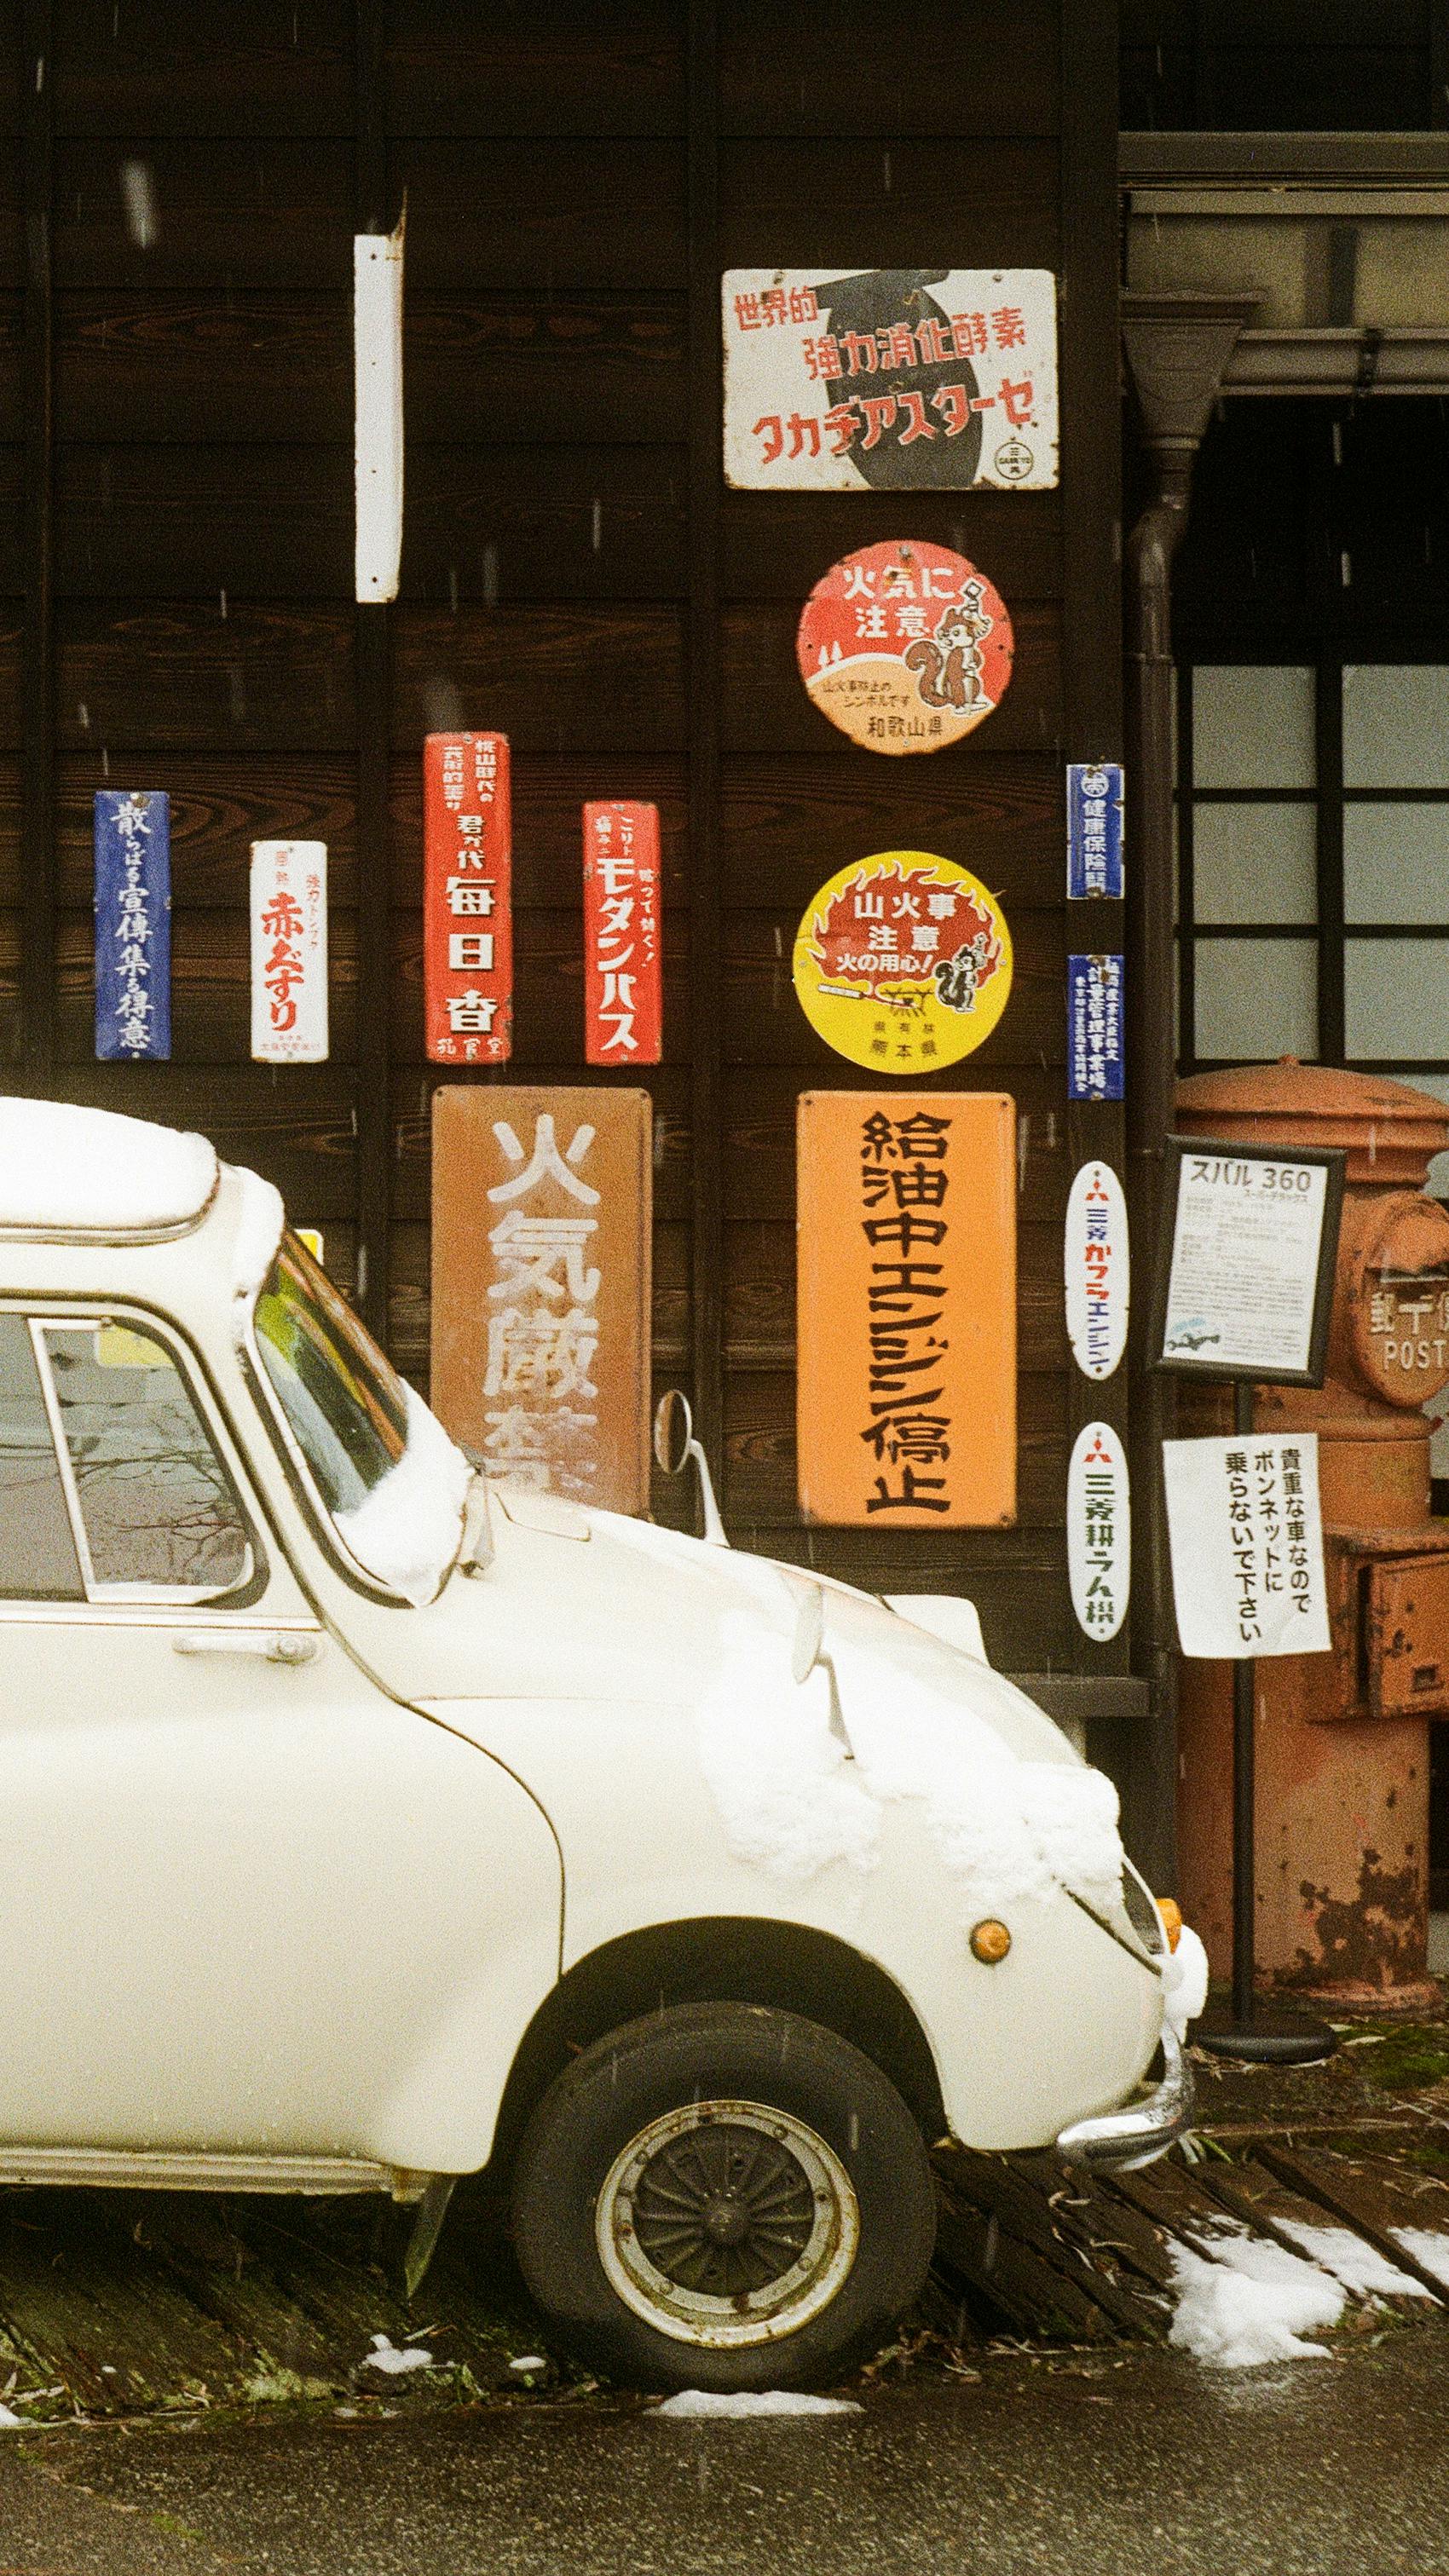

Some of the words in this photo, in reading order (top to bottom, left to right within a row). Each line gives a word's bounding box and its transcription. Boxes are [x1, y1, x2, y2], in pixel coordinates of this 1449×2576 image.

[734, 285, 818, 331] 世界的
[802, 307, 1026, 380] 強力消化酵素
[842, 565, 955, 599] 火気に
[855, 604, 932, 638] 注意
[867, 716, 944, 737] 和歌山県
[854, 891, 956, 920] 山火事
[260, 891, 304, 1032] 赤ぐすり
[445, 876, 498, 1034] 毎日香
[596, 857, 638, 1052] モダンパス
[869, 925, 940, 952] 注意
[836, 954, 933, 973] 火の用心!
[1190, 1160, 1254, 1187] スバル
[1261, 1167, 1313, 1191] 360
[860, 1110, 953, 1514] 給油中エンジン停止
[1383, 1339, 1448, 1372] POST
[1254, 1451, 1284, 1593] ボンネットに
[1280, 1448, 1313, 1614] 貴重な車なので
[1225, 1451, 1261, 1642] 乗らないで下さい
